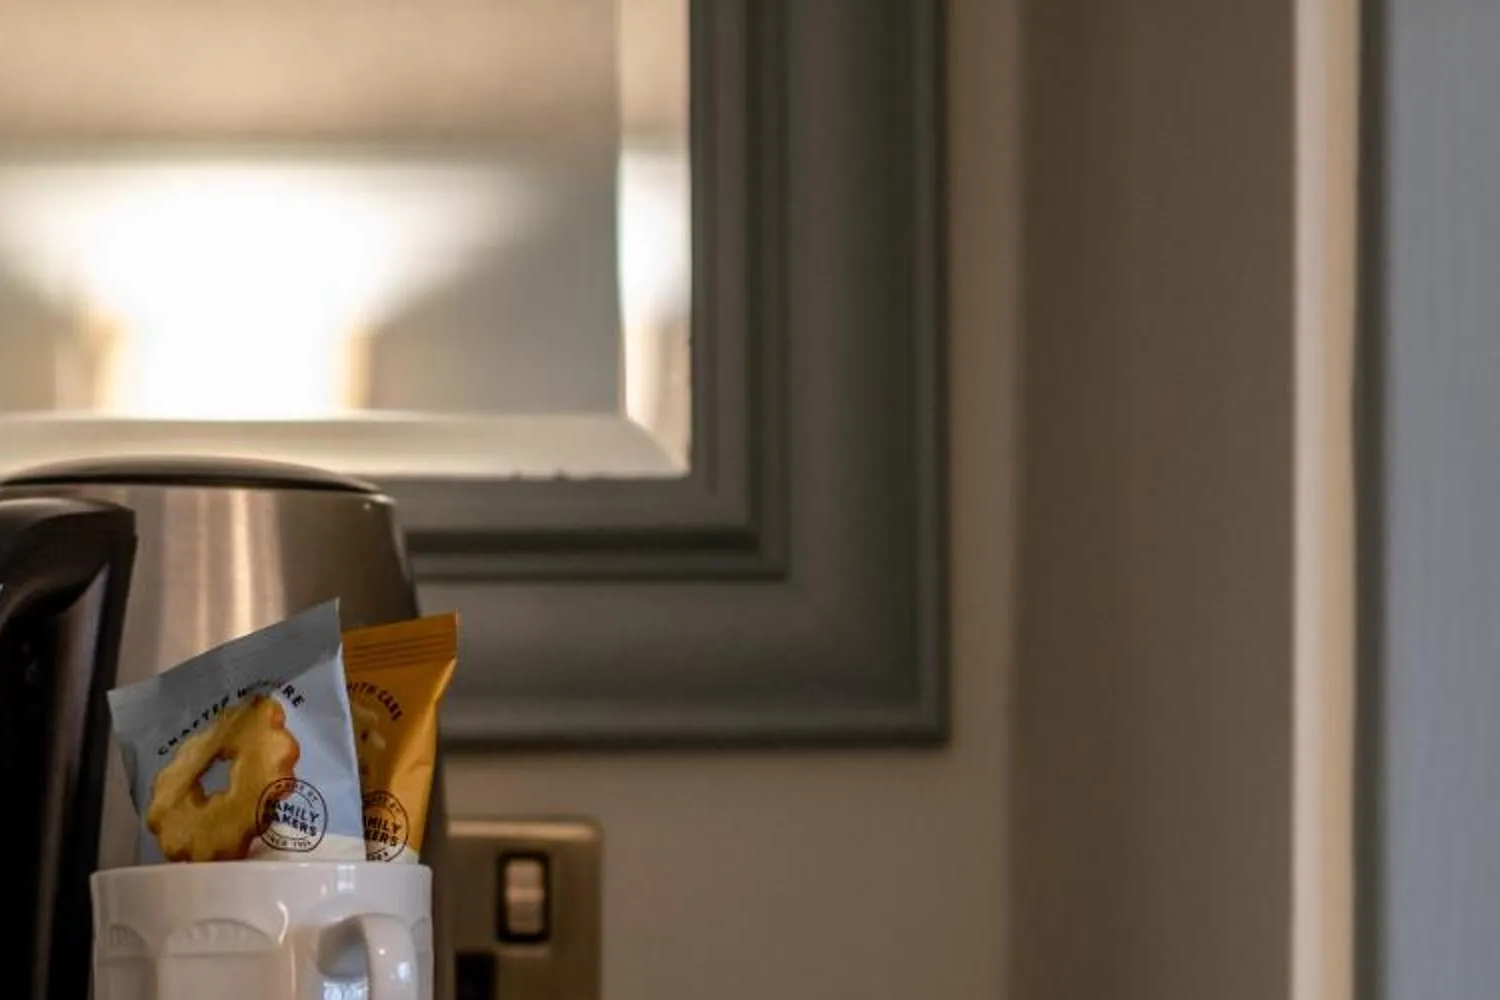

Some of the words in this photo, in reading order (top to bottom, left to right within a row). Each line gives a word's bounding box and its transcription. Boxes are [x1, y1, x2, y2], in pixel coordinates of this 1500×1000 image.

[269, 800, 320, 823] AMILY
[269, 814, 318, 837] AKERS
[363, 815, 401, 834] MILY
